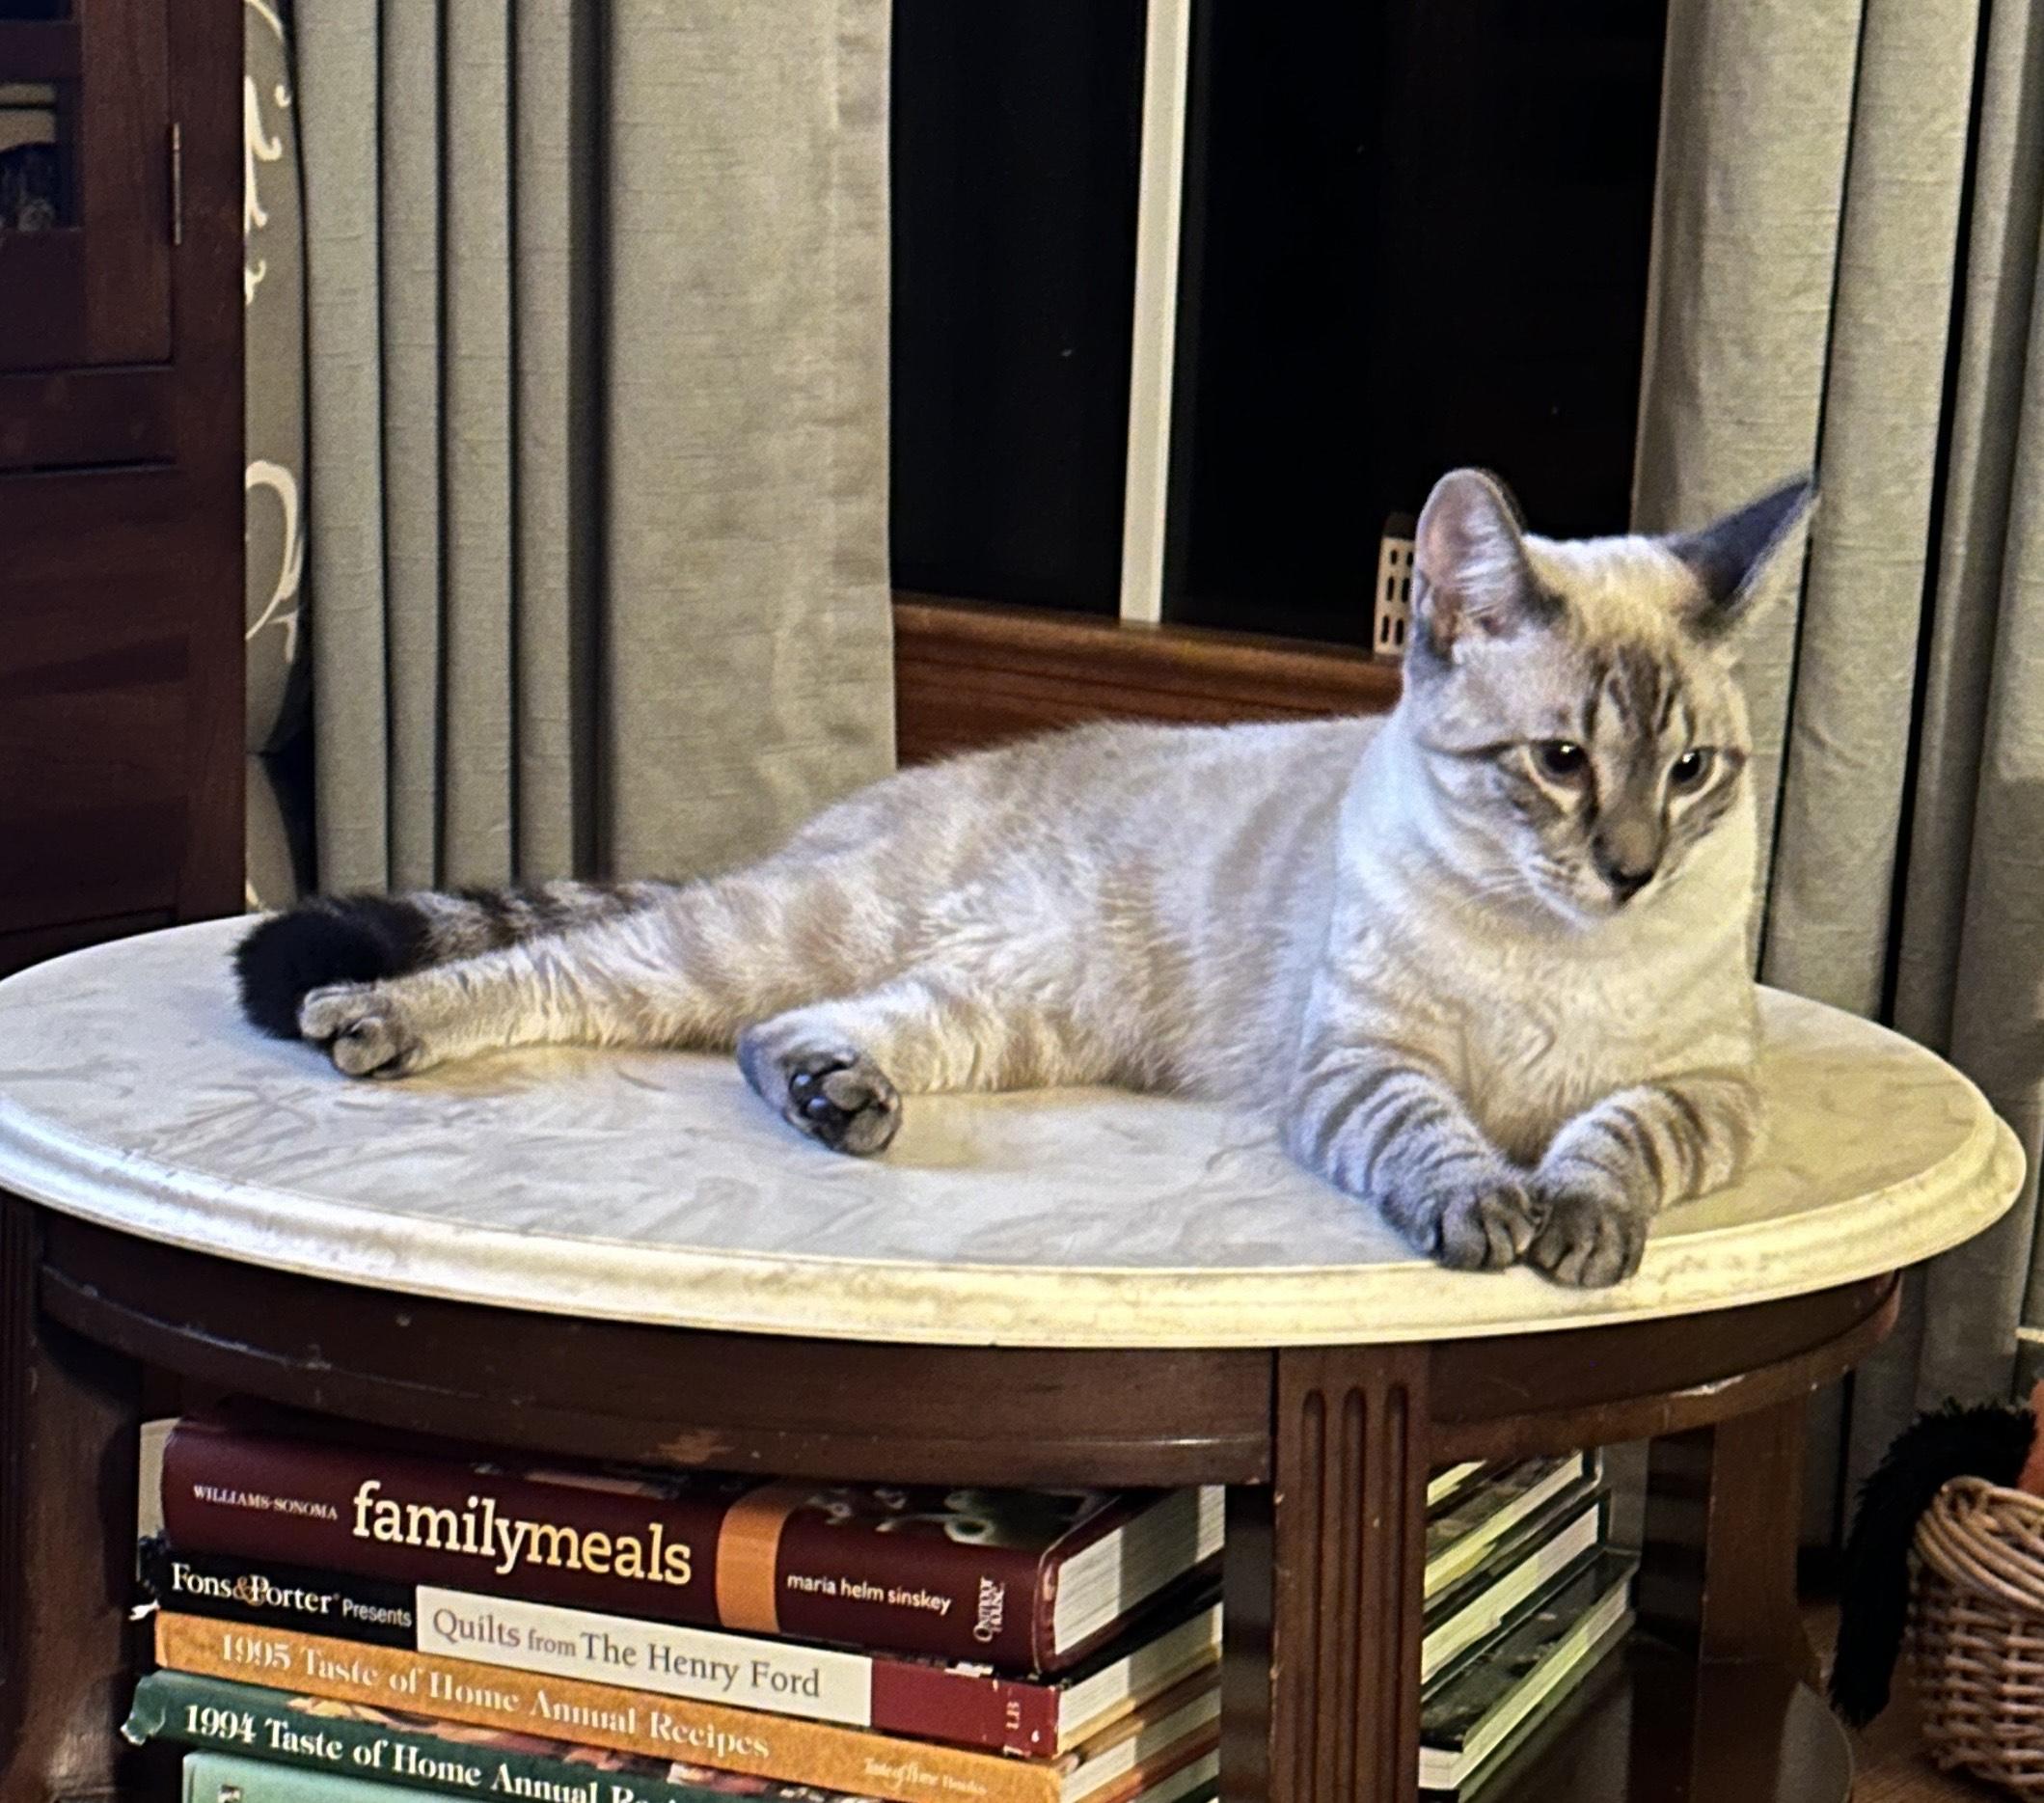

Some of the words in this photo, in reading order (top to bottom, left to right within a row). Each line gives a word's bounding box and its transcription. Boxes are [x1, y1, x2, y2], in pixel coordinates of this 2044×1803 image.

[193, 1485, 339, 1520] WILLIAMS-SONOMA
[353, 1480, 693, 1585] familymeals
[341, 1598, 413, 1628] Presents
[786, 1574, 836, 1595] maria
[840, 1577, 885, 1602] helm
[887, 1586, 952, 1616] sinskey
[222, 1633, 291, 1670] 1995
[300, 1647, 379, 1687] Taste
[389, 1667, 424, 1695] of
[429, 1671, 520, 1712] Home
[530, 1689, 638, 1735] Annual
[649, 1710, 771, 1759] Recipes
[433, 1608, 522, 1648] Quilts
[528, 1628, 577, 1657] from
[580, 1631, 638, 1668] The
[648, 1643, 740, 1692] Henry
[750, 1659, 820, 1698] Ford
[184, 1704, 258, 1744] 1994
[263, 1717, 343, 1761] Taste
[352, 1738, 389, 1768] of
[394, 1743, 482, 1787] Home
[490, 1762, 599, 1803] Annual
